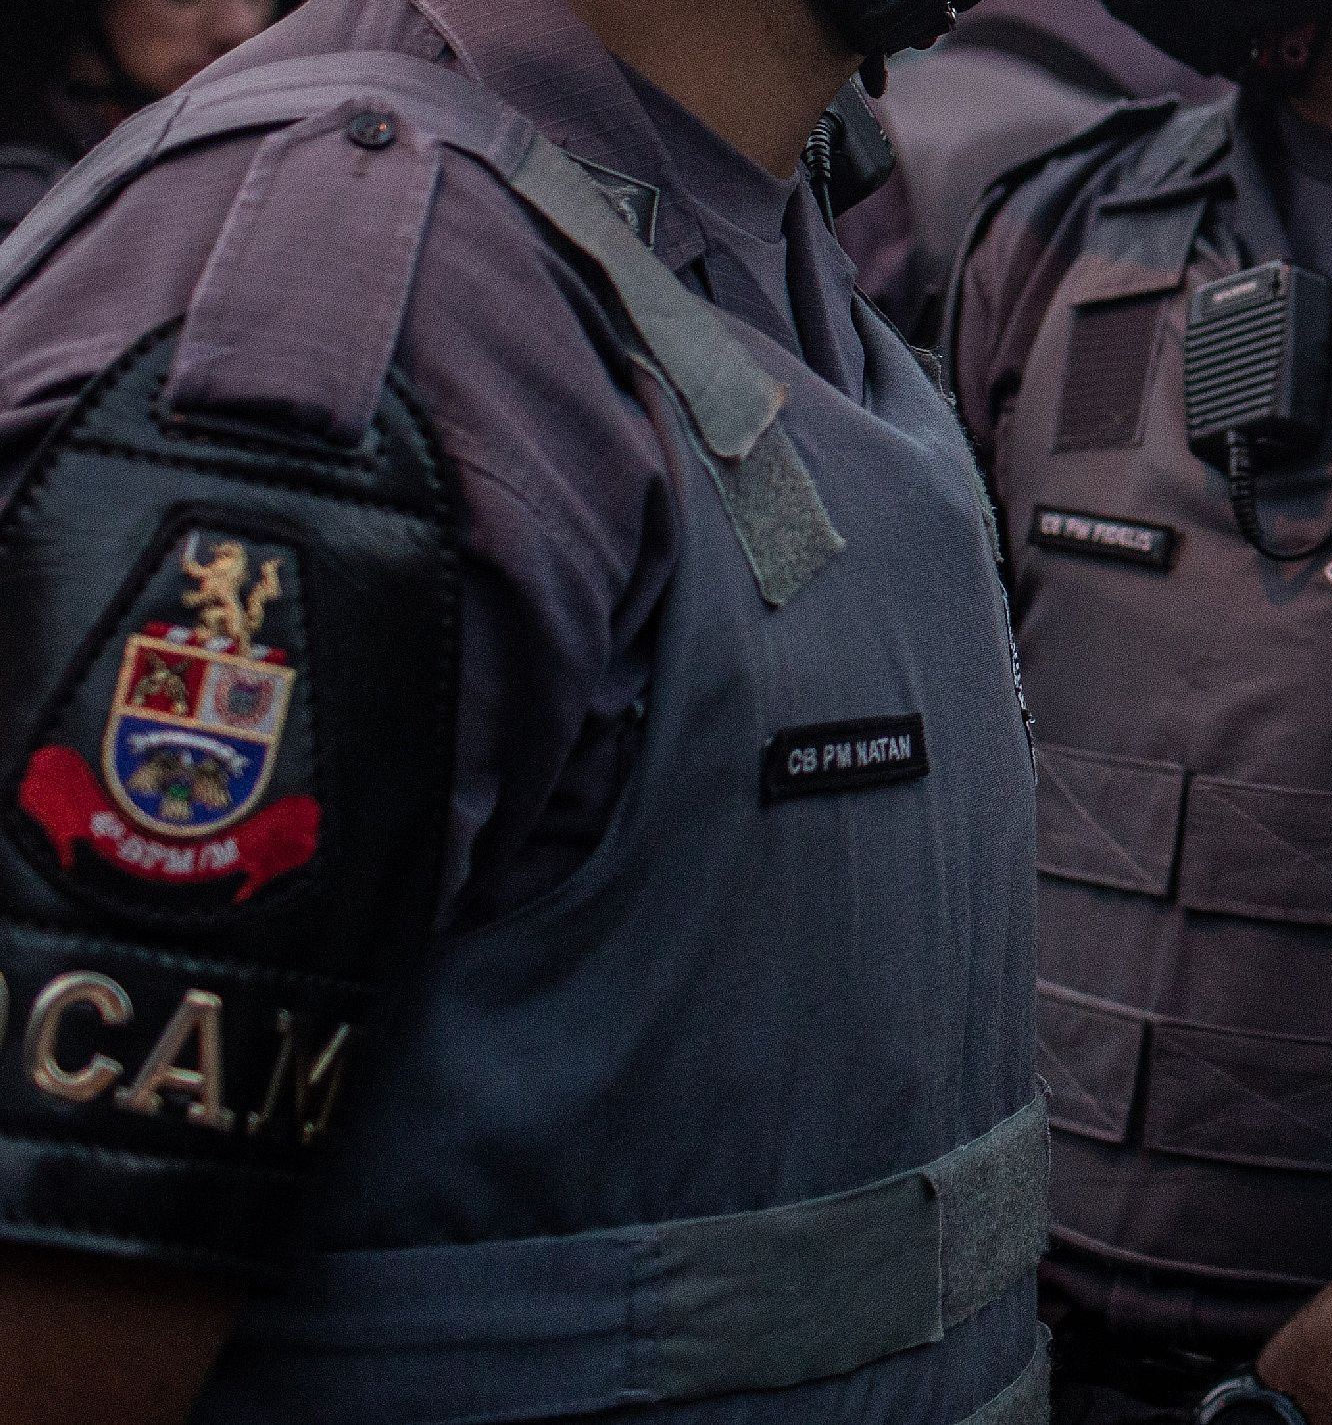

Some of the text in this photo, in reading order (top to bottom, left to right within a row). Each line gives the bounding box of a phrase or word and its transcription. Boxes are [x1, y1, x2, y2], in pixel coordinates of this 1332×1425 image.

[788, 734, 911, 776] CB PM NATAN
[0, 969, 352, 1144] CAM
